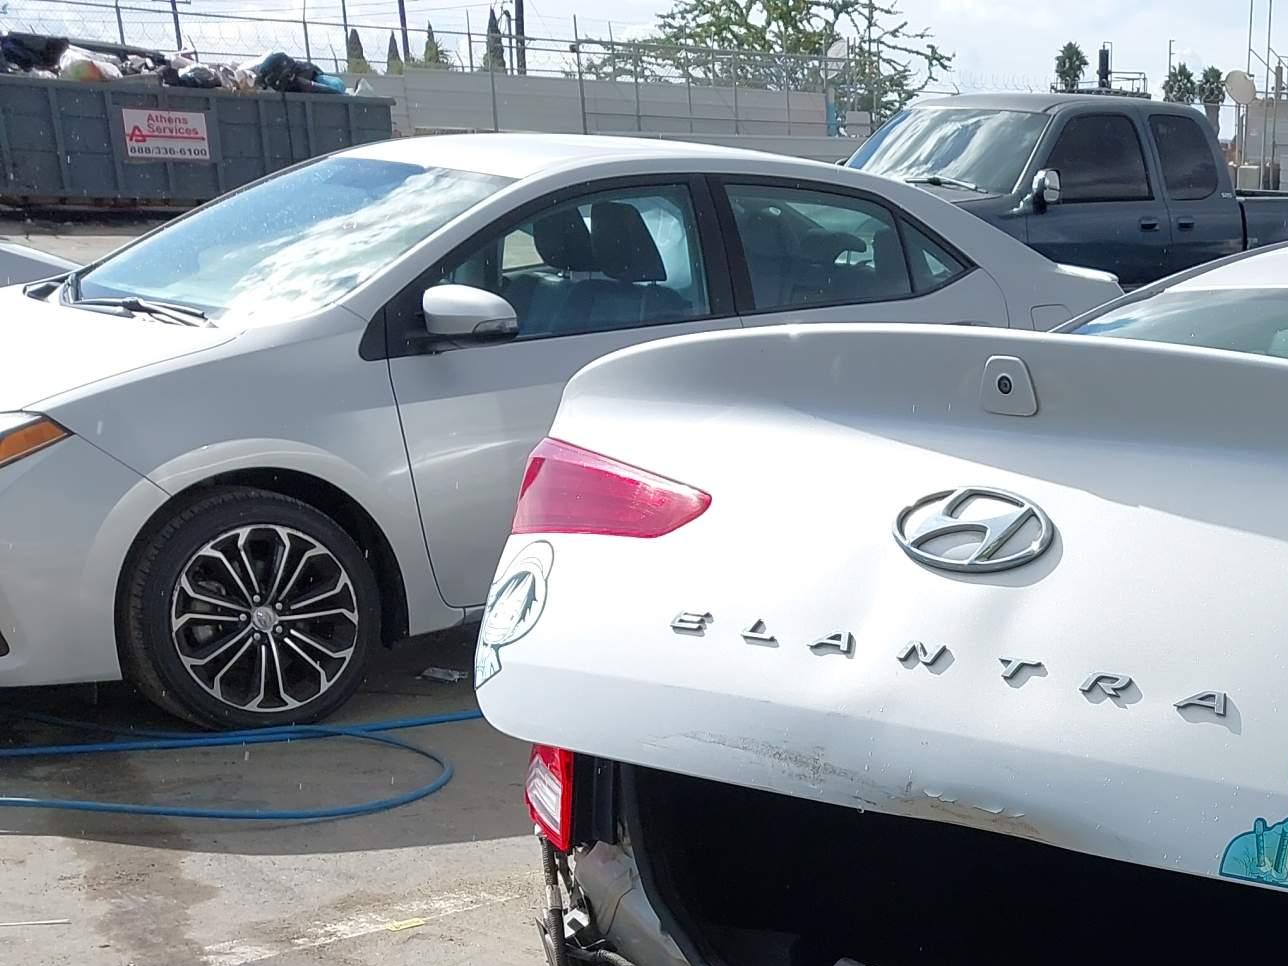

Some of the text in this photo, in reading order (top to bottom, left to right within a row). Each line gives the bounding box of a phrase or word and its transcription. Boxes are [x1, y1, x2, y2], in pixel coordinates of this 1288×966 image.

[147, 113, 189, 125] Athens
[147, 123, 198, 136] Services
[130, 145, 208, 157] 888/336-6100
[669, 611, 1229, 717] ELANTRA
